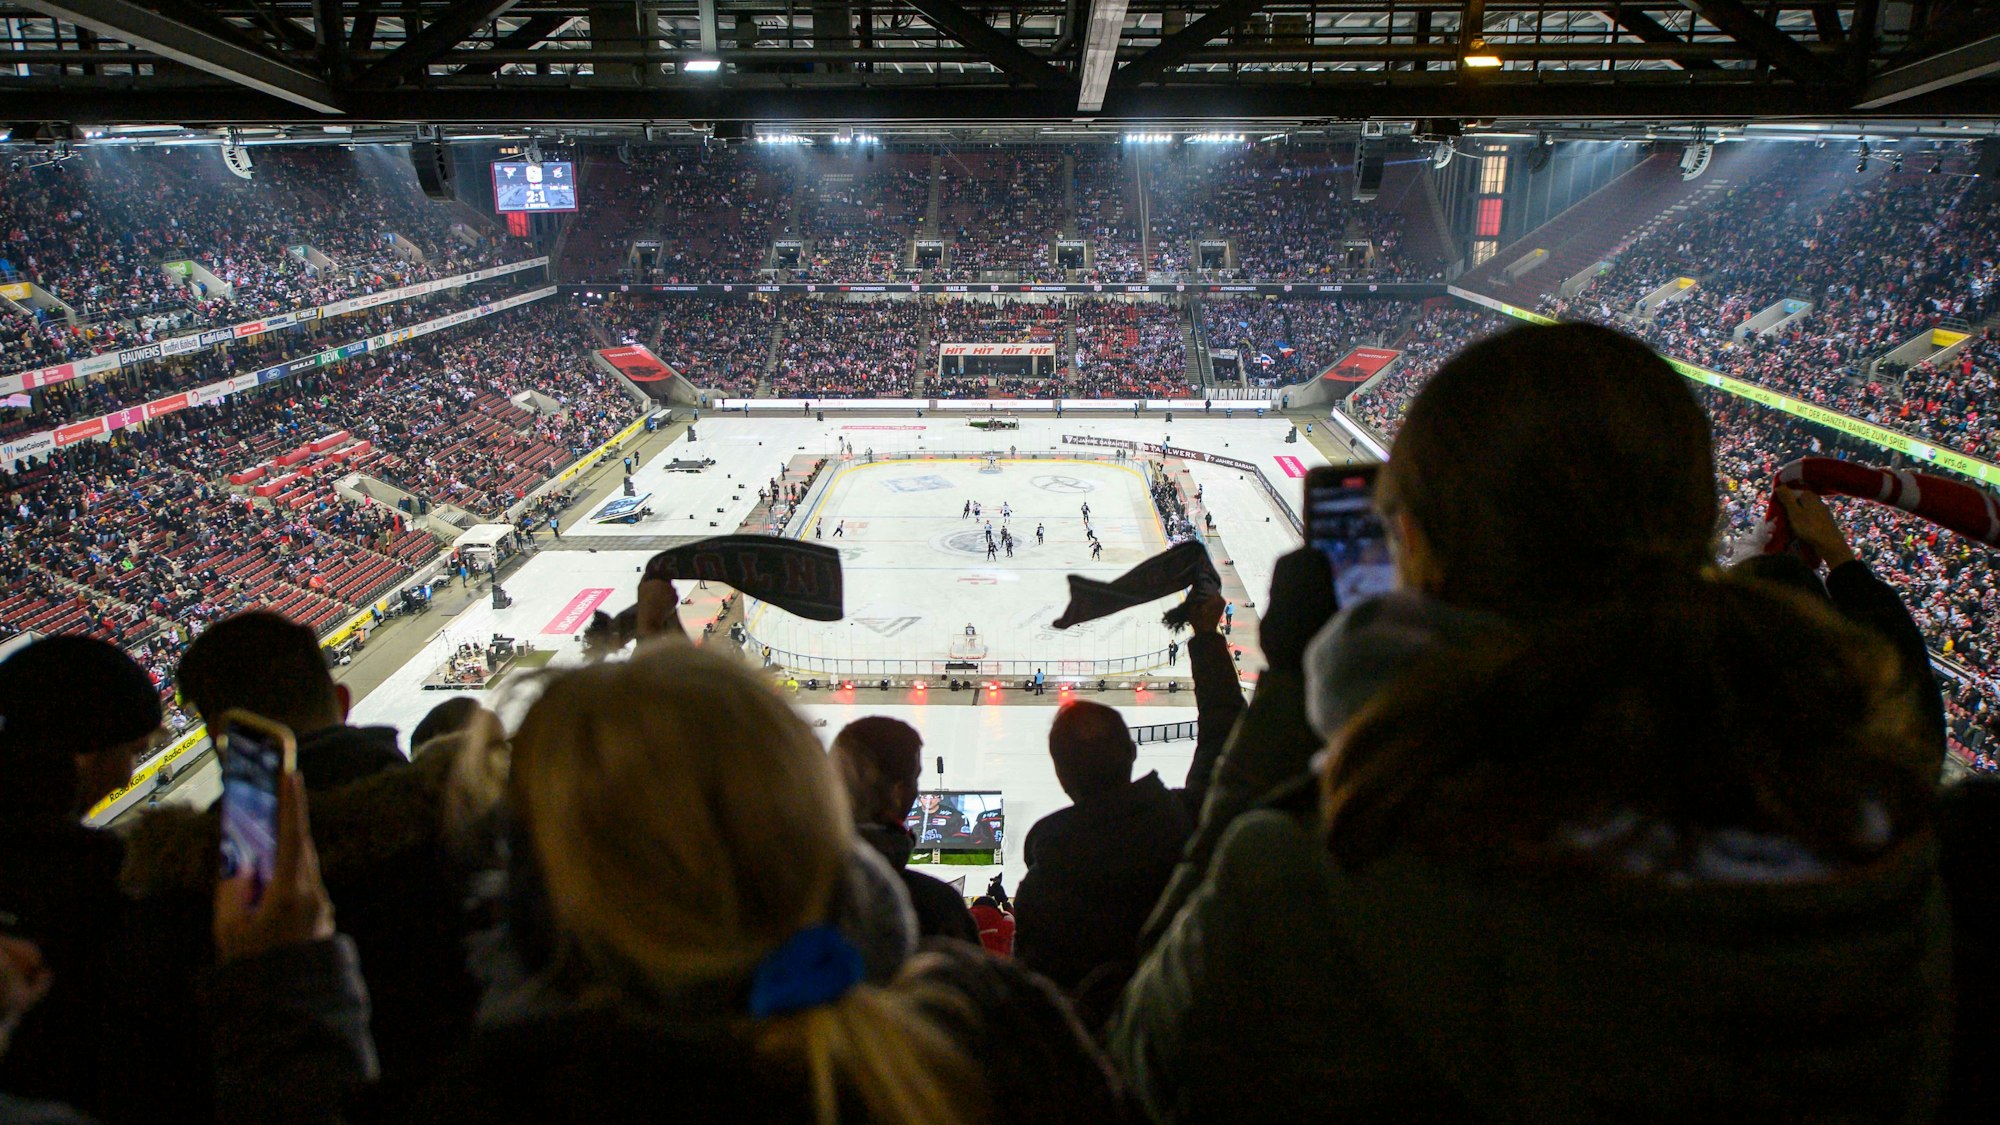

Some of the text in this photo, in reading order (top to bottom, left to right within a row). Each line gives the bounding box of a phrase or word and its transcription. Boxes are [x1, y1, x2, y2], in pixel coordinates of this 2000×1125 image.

[121, 345, 160, 364] BAUWENS
[321, 350, 340, 364] DEVK
[1206, 388, 1282, 401] MANNHEIM
[1796, 405, 1808, 414] MIT
[1808, 409, 1820, 419] DER
[1822, 413, 1846, 428] GANZEN
[1847, 422, 1870, 437] BANDE
[1871, 429, 1887, 442] ZUM
[15, 438, 51, 454] NetCologne
[1216, 457, 1234, 467] JAHRE
[1943, 456, 1967, 471] vrs.de
[164, 737, 196, 763] Radio Köln
[109, 772, 146, 802] Radio Köln
